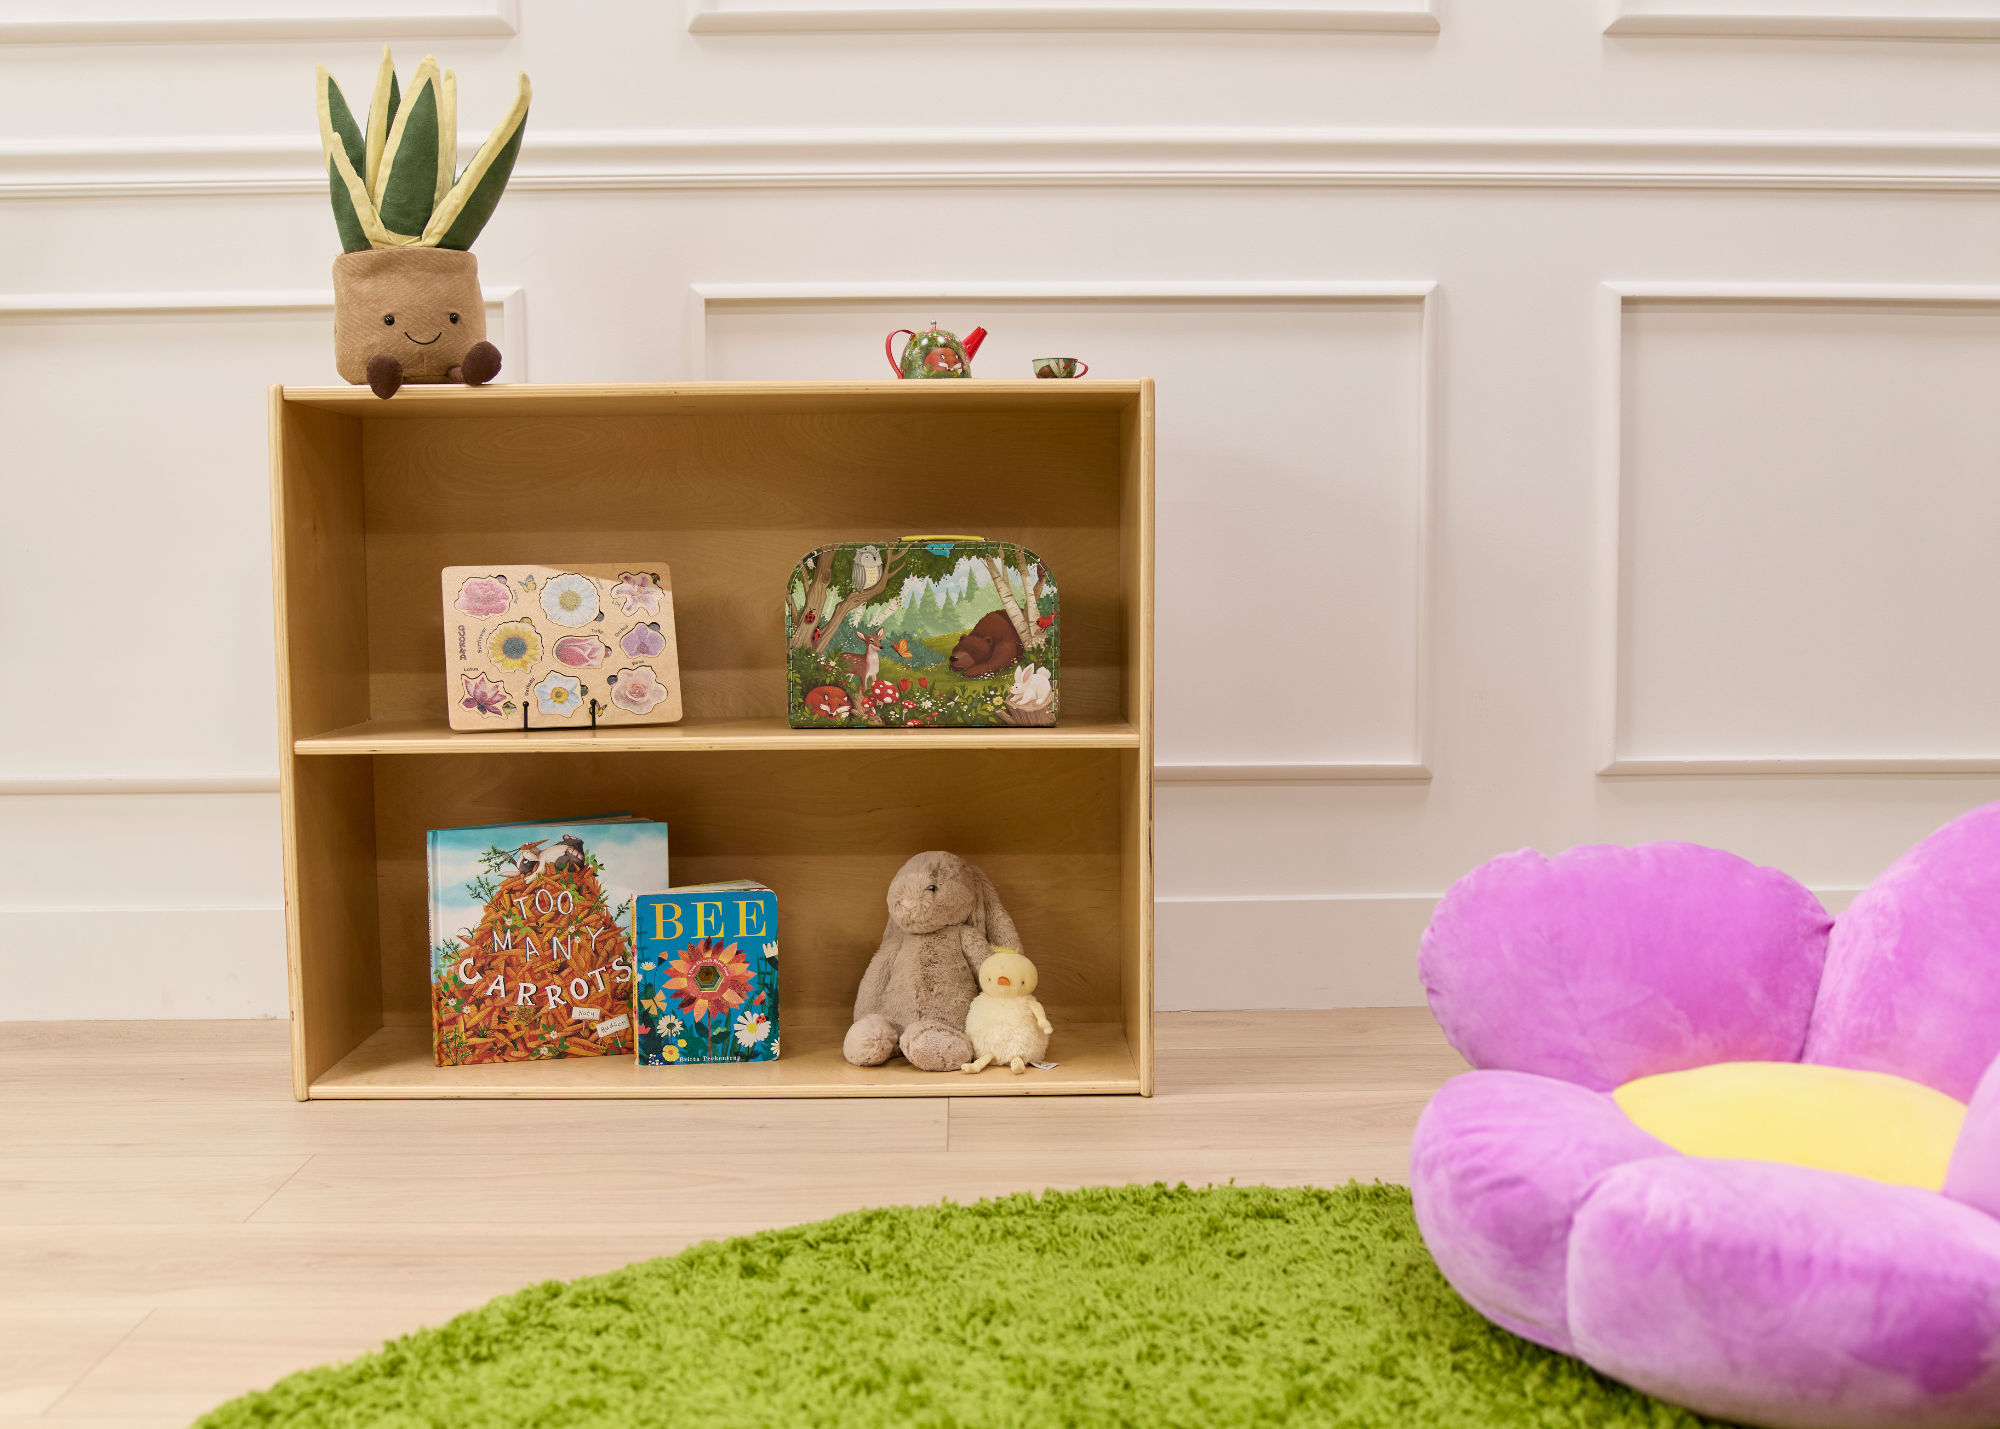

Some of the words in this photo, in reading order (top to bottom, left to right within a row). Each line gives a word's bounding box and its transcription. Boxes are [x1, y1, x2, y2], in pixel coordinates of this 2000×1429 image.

[512, 888, 574, 920] TOO
[649, 900, 766, 941] BEE
[491, 925, 605, 962] MANY
[458, 955, 633, 1010] CARROTS
[578, 1010, 595, 1018] Katy
